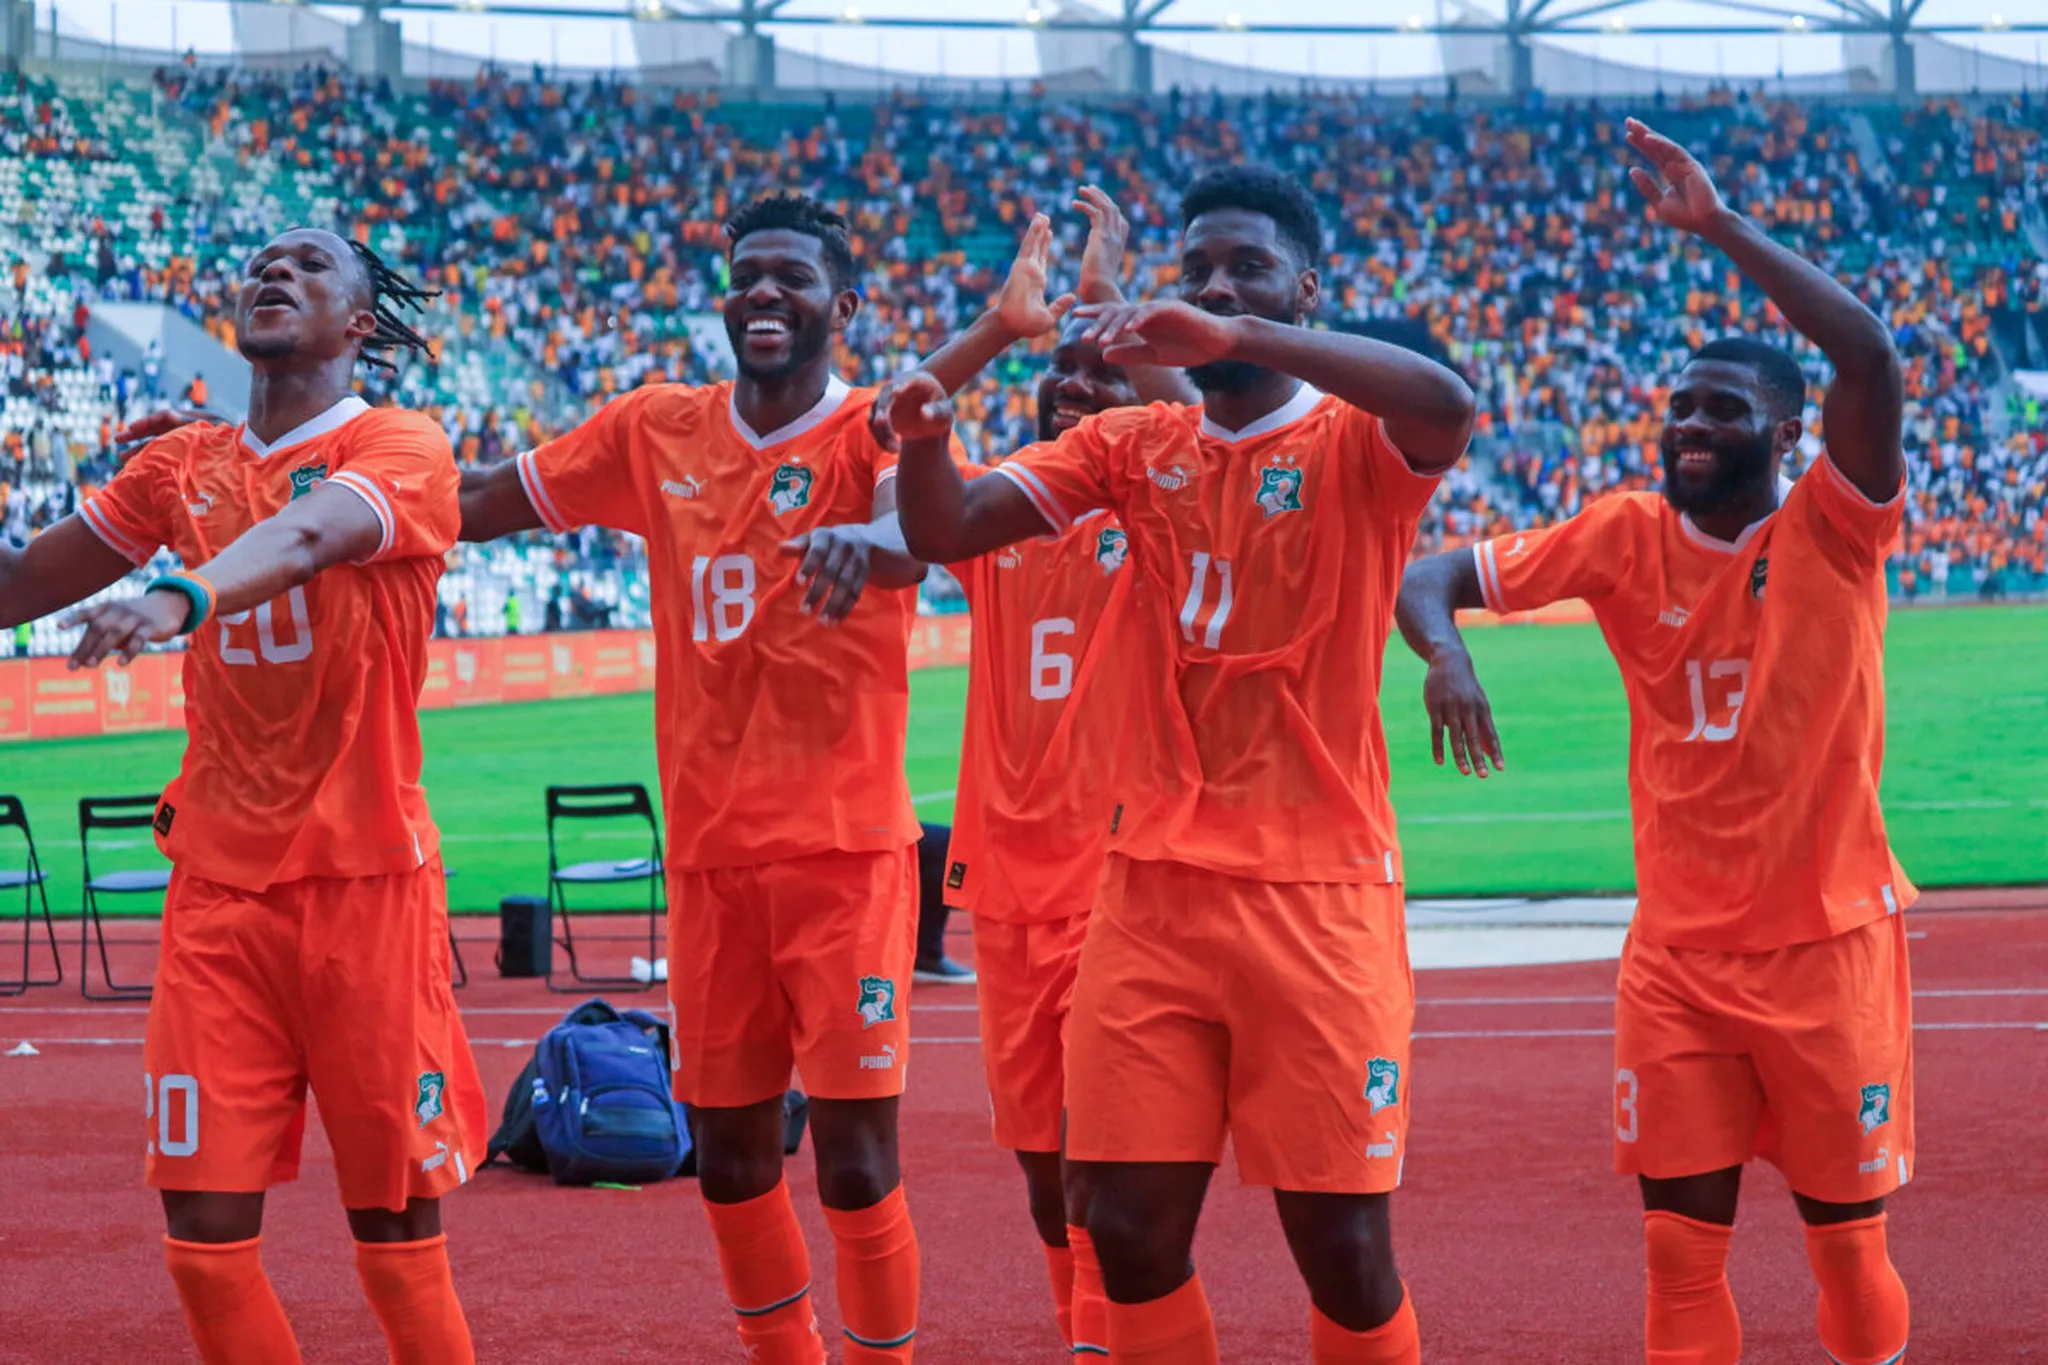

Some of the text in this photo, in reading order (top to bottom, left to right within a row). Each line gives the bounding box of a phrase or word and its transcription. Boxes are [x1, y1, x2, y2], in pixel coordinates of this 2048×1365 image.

[692, 554, 756, 642] 18
[1180, 551, 1233, 650] 11
[1030, 616, 1075, 701] 6
[1683, 658, 1750, 742] 13
